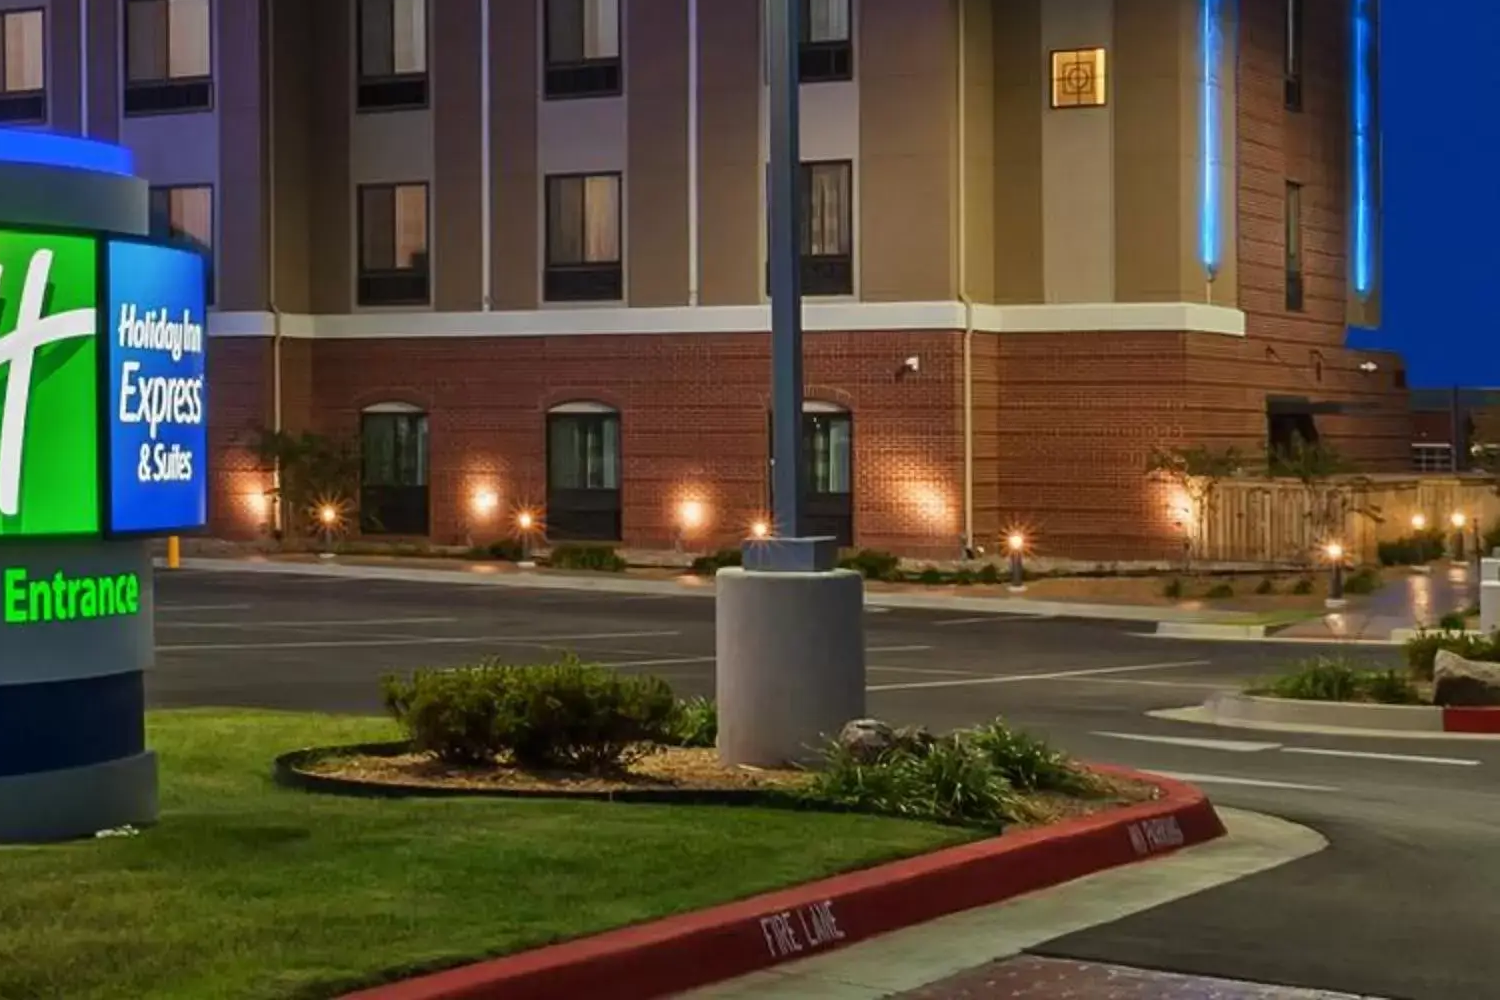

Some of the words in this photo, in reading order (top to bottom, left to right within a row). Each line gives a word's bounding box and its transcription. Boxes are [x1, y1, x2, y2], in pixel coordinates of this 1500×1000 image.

[118, 303, 184, 361] Holiday
[183, 309, 203, 353] Inn
[119, 361, 202, 440] Express
[138, 443, 151, 482] &
[153, 443, 193, 481] Suites
[4, 567, 140, 622] Entrance
[760, 911, 803, 957] FIRE
[797, 900, 846, 946] LANE
